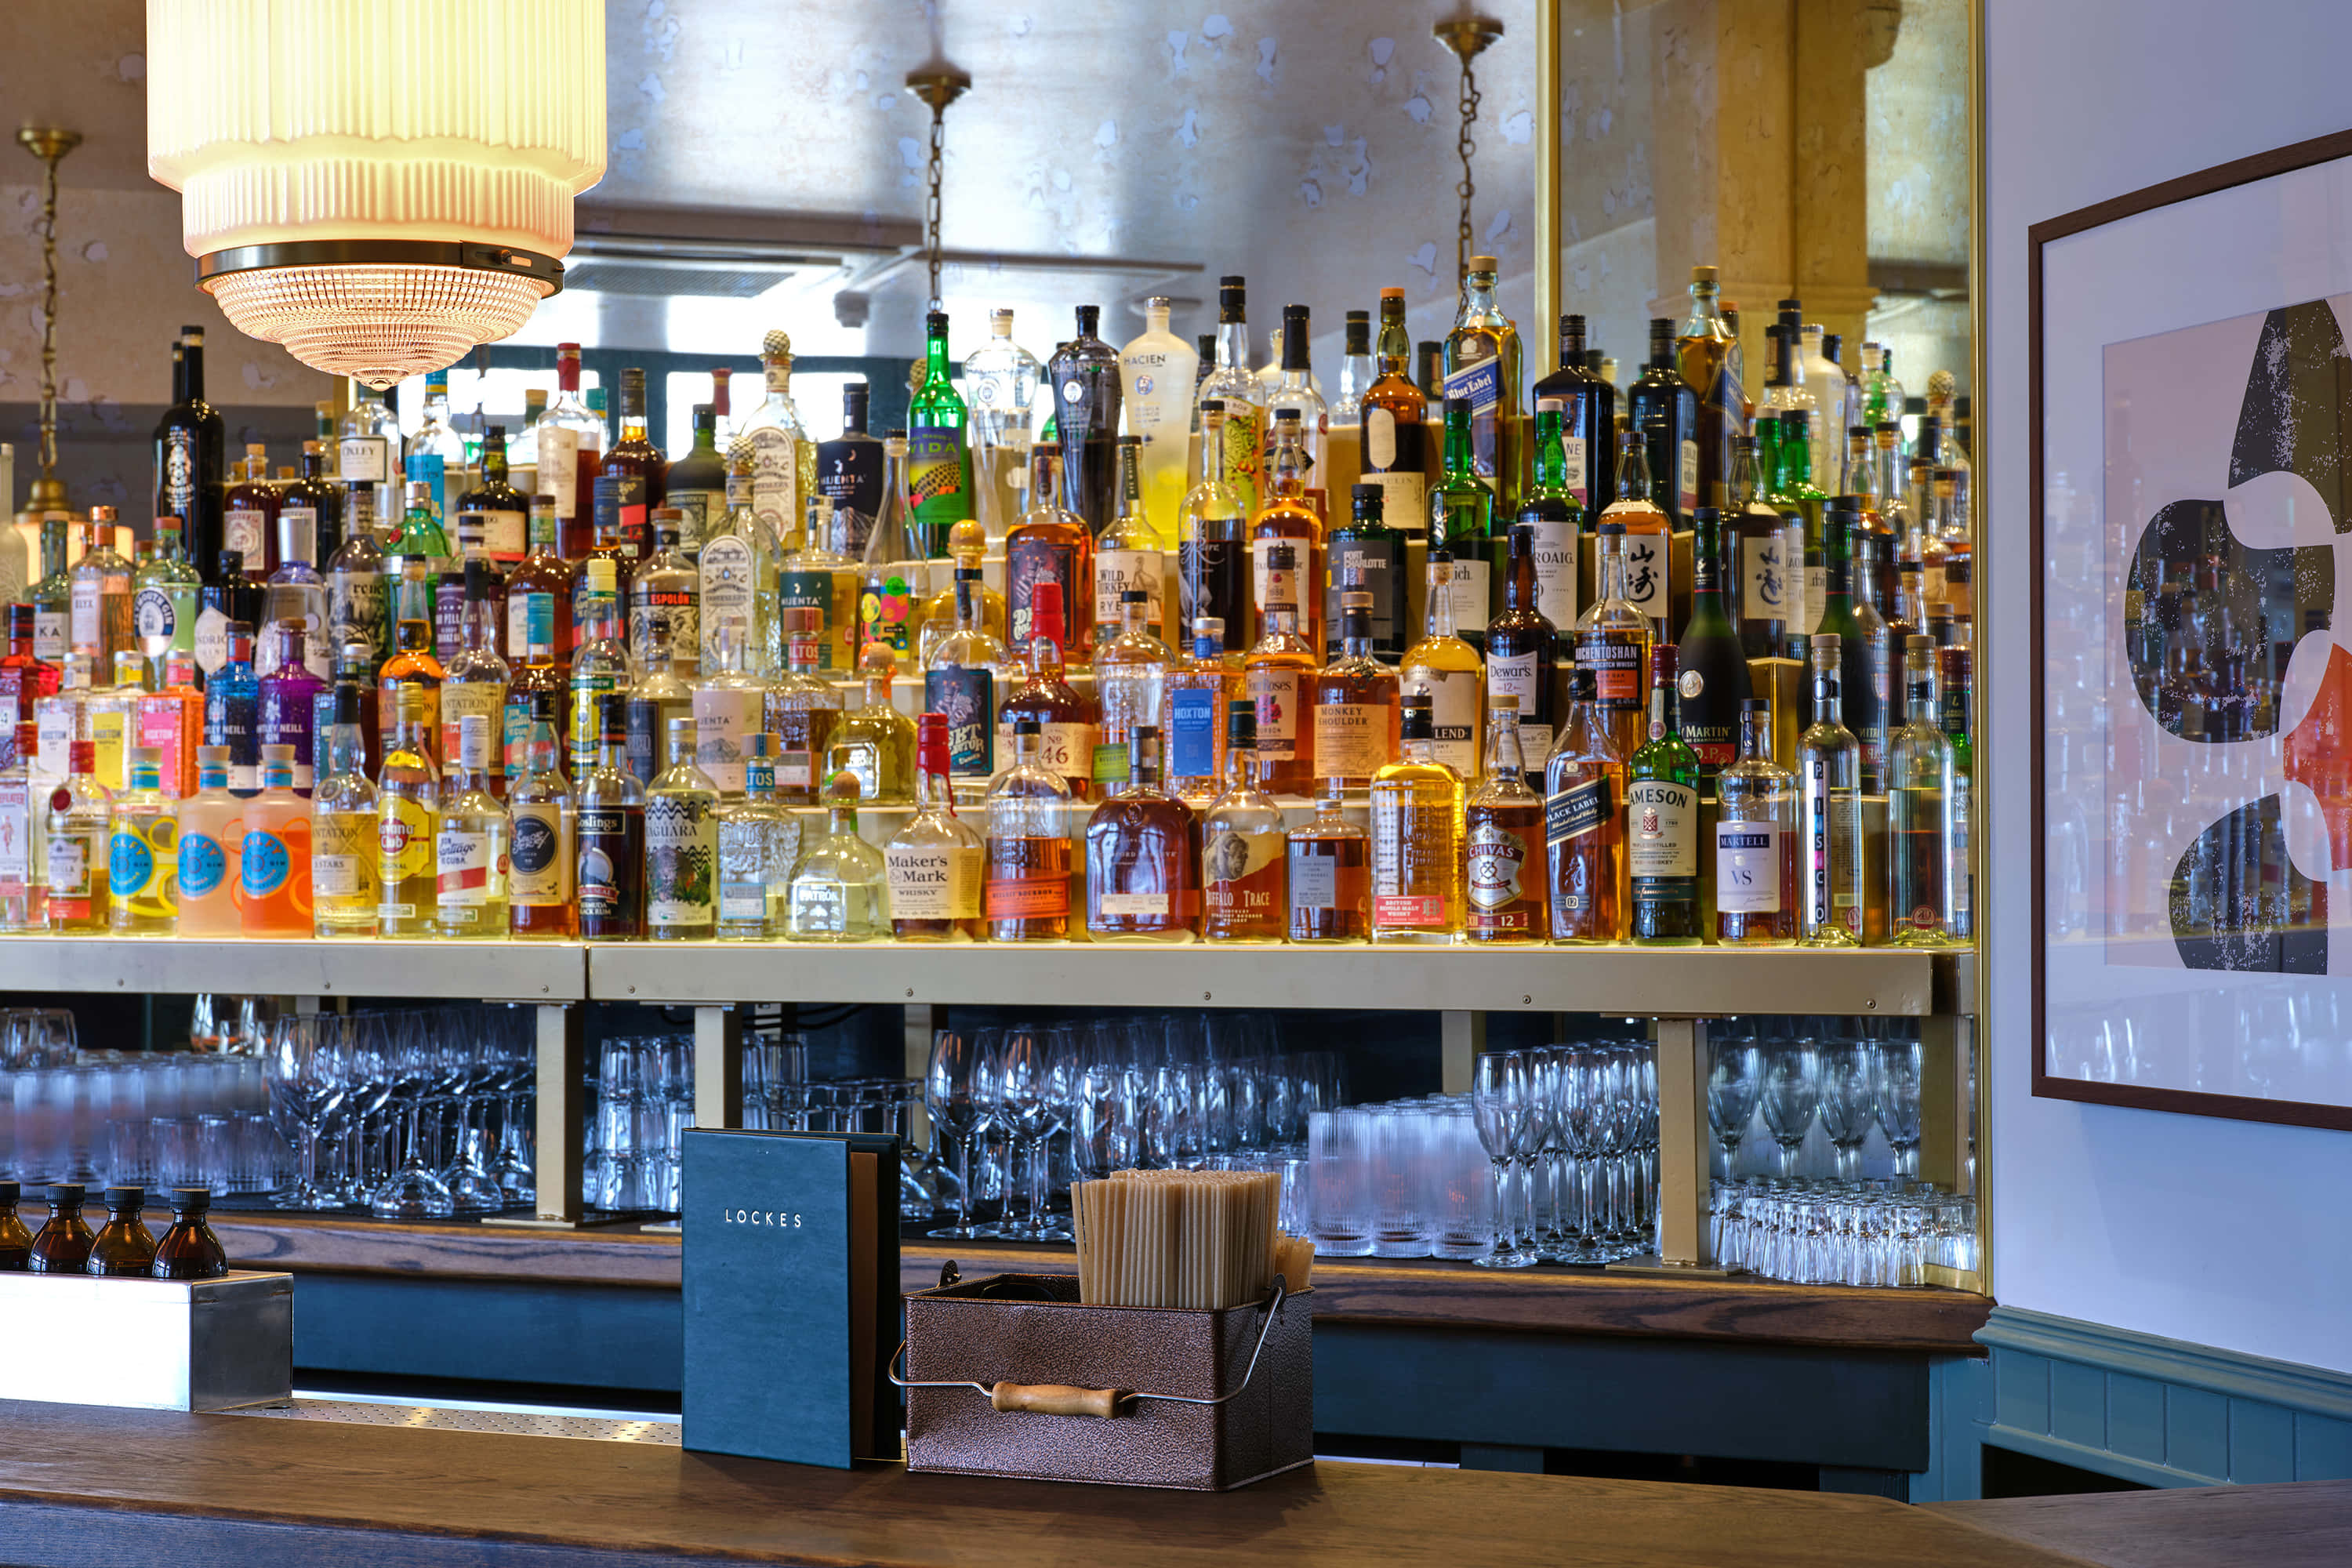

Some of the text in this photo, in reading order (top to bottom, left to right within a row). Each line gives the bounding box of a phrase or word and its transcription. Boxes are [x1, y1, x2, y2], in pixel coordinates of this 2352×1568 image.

[1124, 354, 1167, 365] HACIEN
[1468, 374, 1493, 393] Label
[909, 441, 957, 454] VIDA
[1343, 558, 1387, 568] CHARLOTTE
[1534, 551, 1573, 564] ROAIG
[1099, 570, 1124, 582] WILD
[650, 593, 690, 605] ESPOLÓN
[1100, 601, 1122, 612] RYE
[1490, 665, 1532, 678] Dewar's
[1174, 706, 1211, 720] HOXTON
[1321, 706, 1363, 717] MONKEY
[280, 723, 304, 733] NEILL
[1318, 717, 1369, 727] SHOULDER
[223, 724, 246, 735] NEILL
[1434, 728, 1467, 740] LEND
[1686, 725, 1729, 738] MARTIN
[1573, 797, 1600, 812] LABEL
[1629, 789, 1688, 810] AMESON
[380, 835, 404, 849] Club
[1720, 836, 1766, 847] MARTELL
[1469, 845, 1515, 858] CHIVAS
[887, 855, 948, 867] Maker's
[903, 870, 948, 883] Mark
[1730, 869, 1752, 885] VS
[1243, 889, 1270, 907] TRACE
[1567, 898, 1577, 906] 12
[1501, 915, 1515, 927] 12
[724, 1207, 802, 1229] LOCKES
